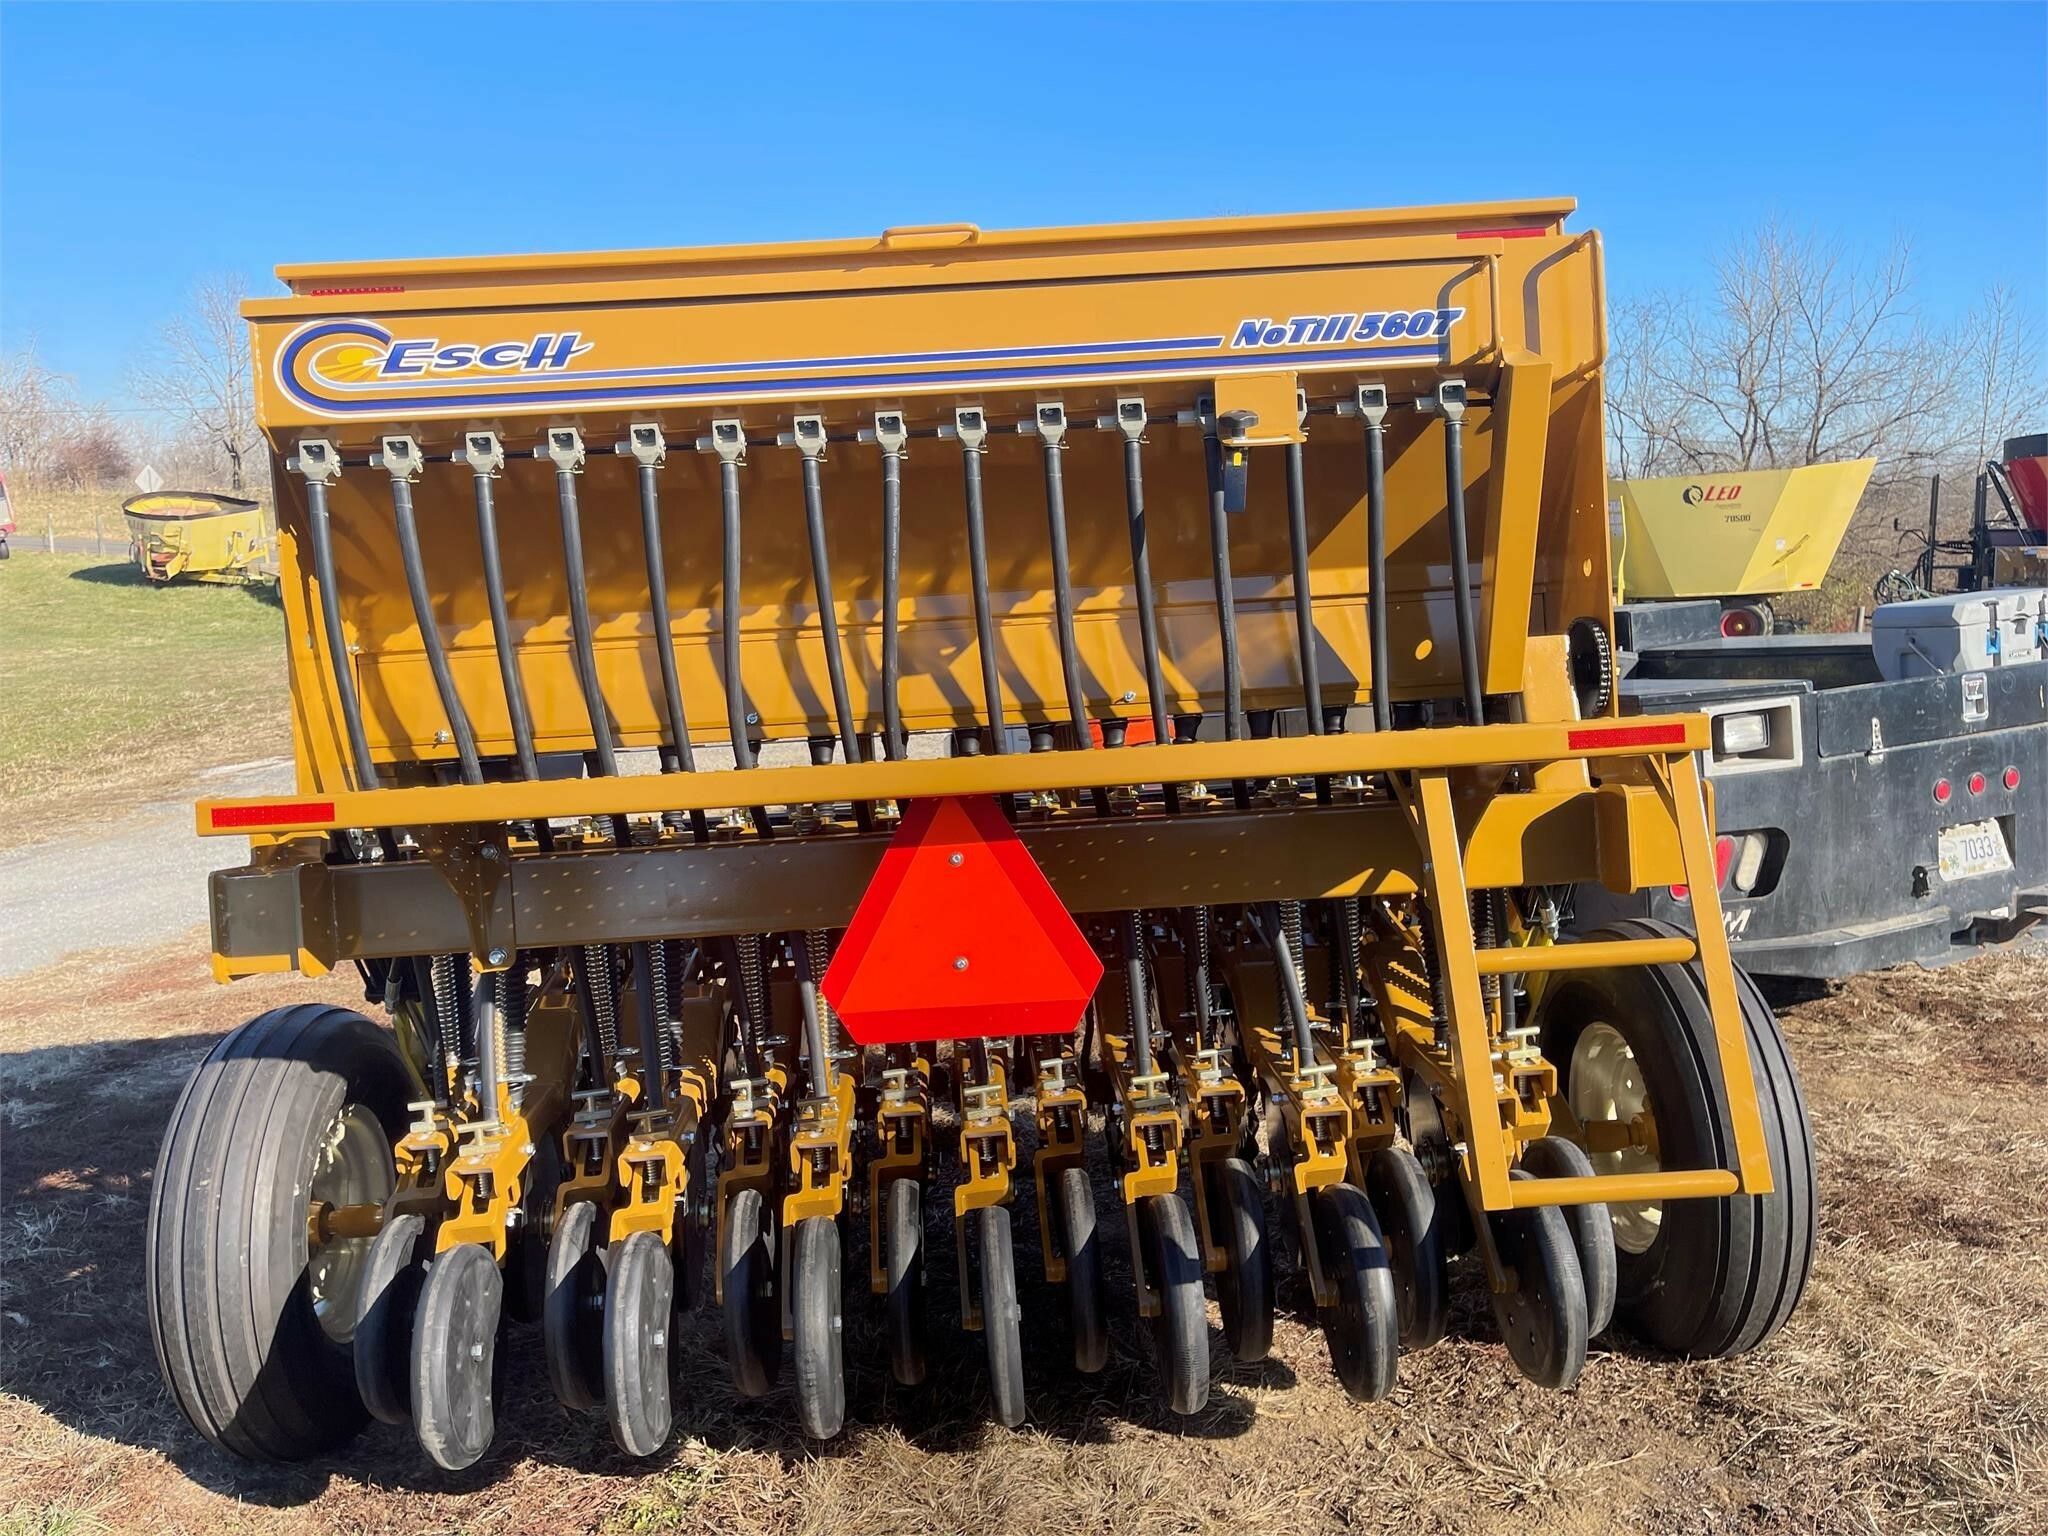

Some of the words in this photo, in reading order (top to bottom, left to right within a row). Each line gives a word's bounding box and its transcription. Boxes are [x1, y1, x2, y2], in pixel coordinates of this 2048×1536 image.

[1231, 314, 1355, 347] NoTill
[1354, 308, 1465, 340] 5607
[1704, 485, 1742, 501] LEO
